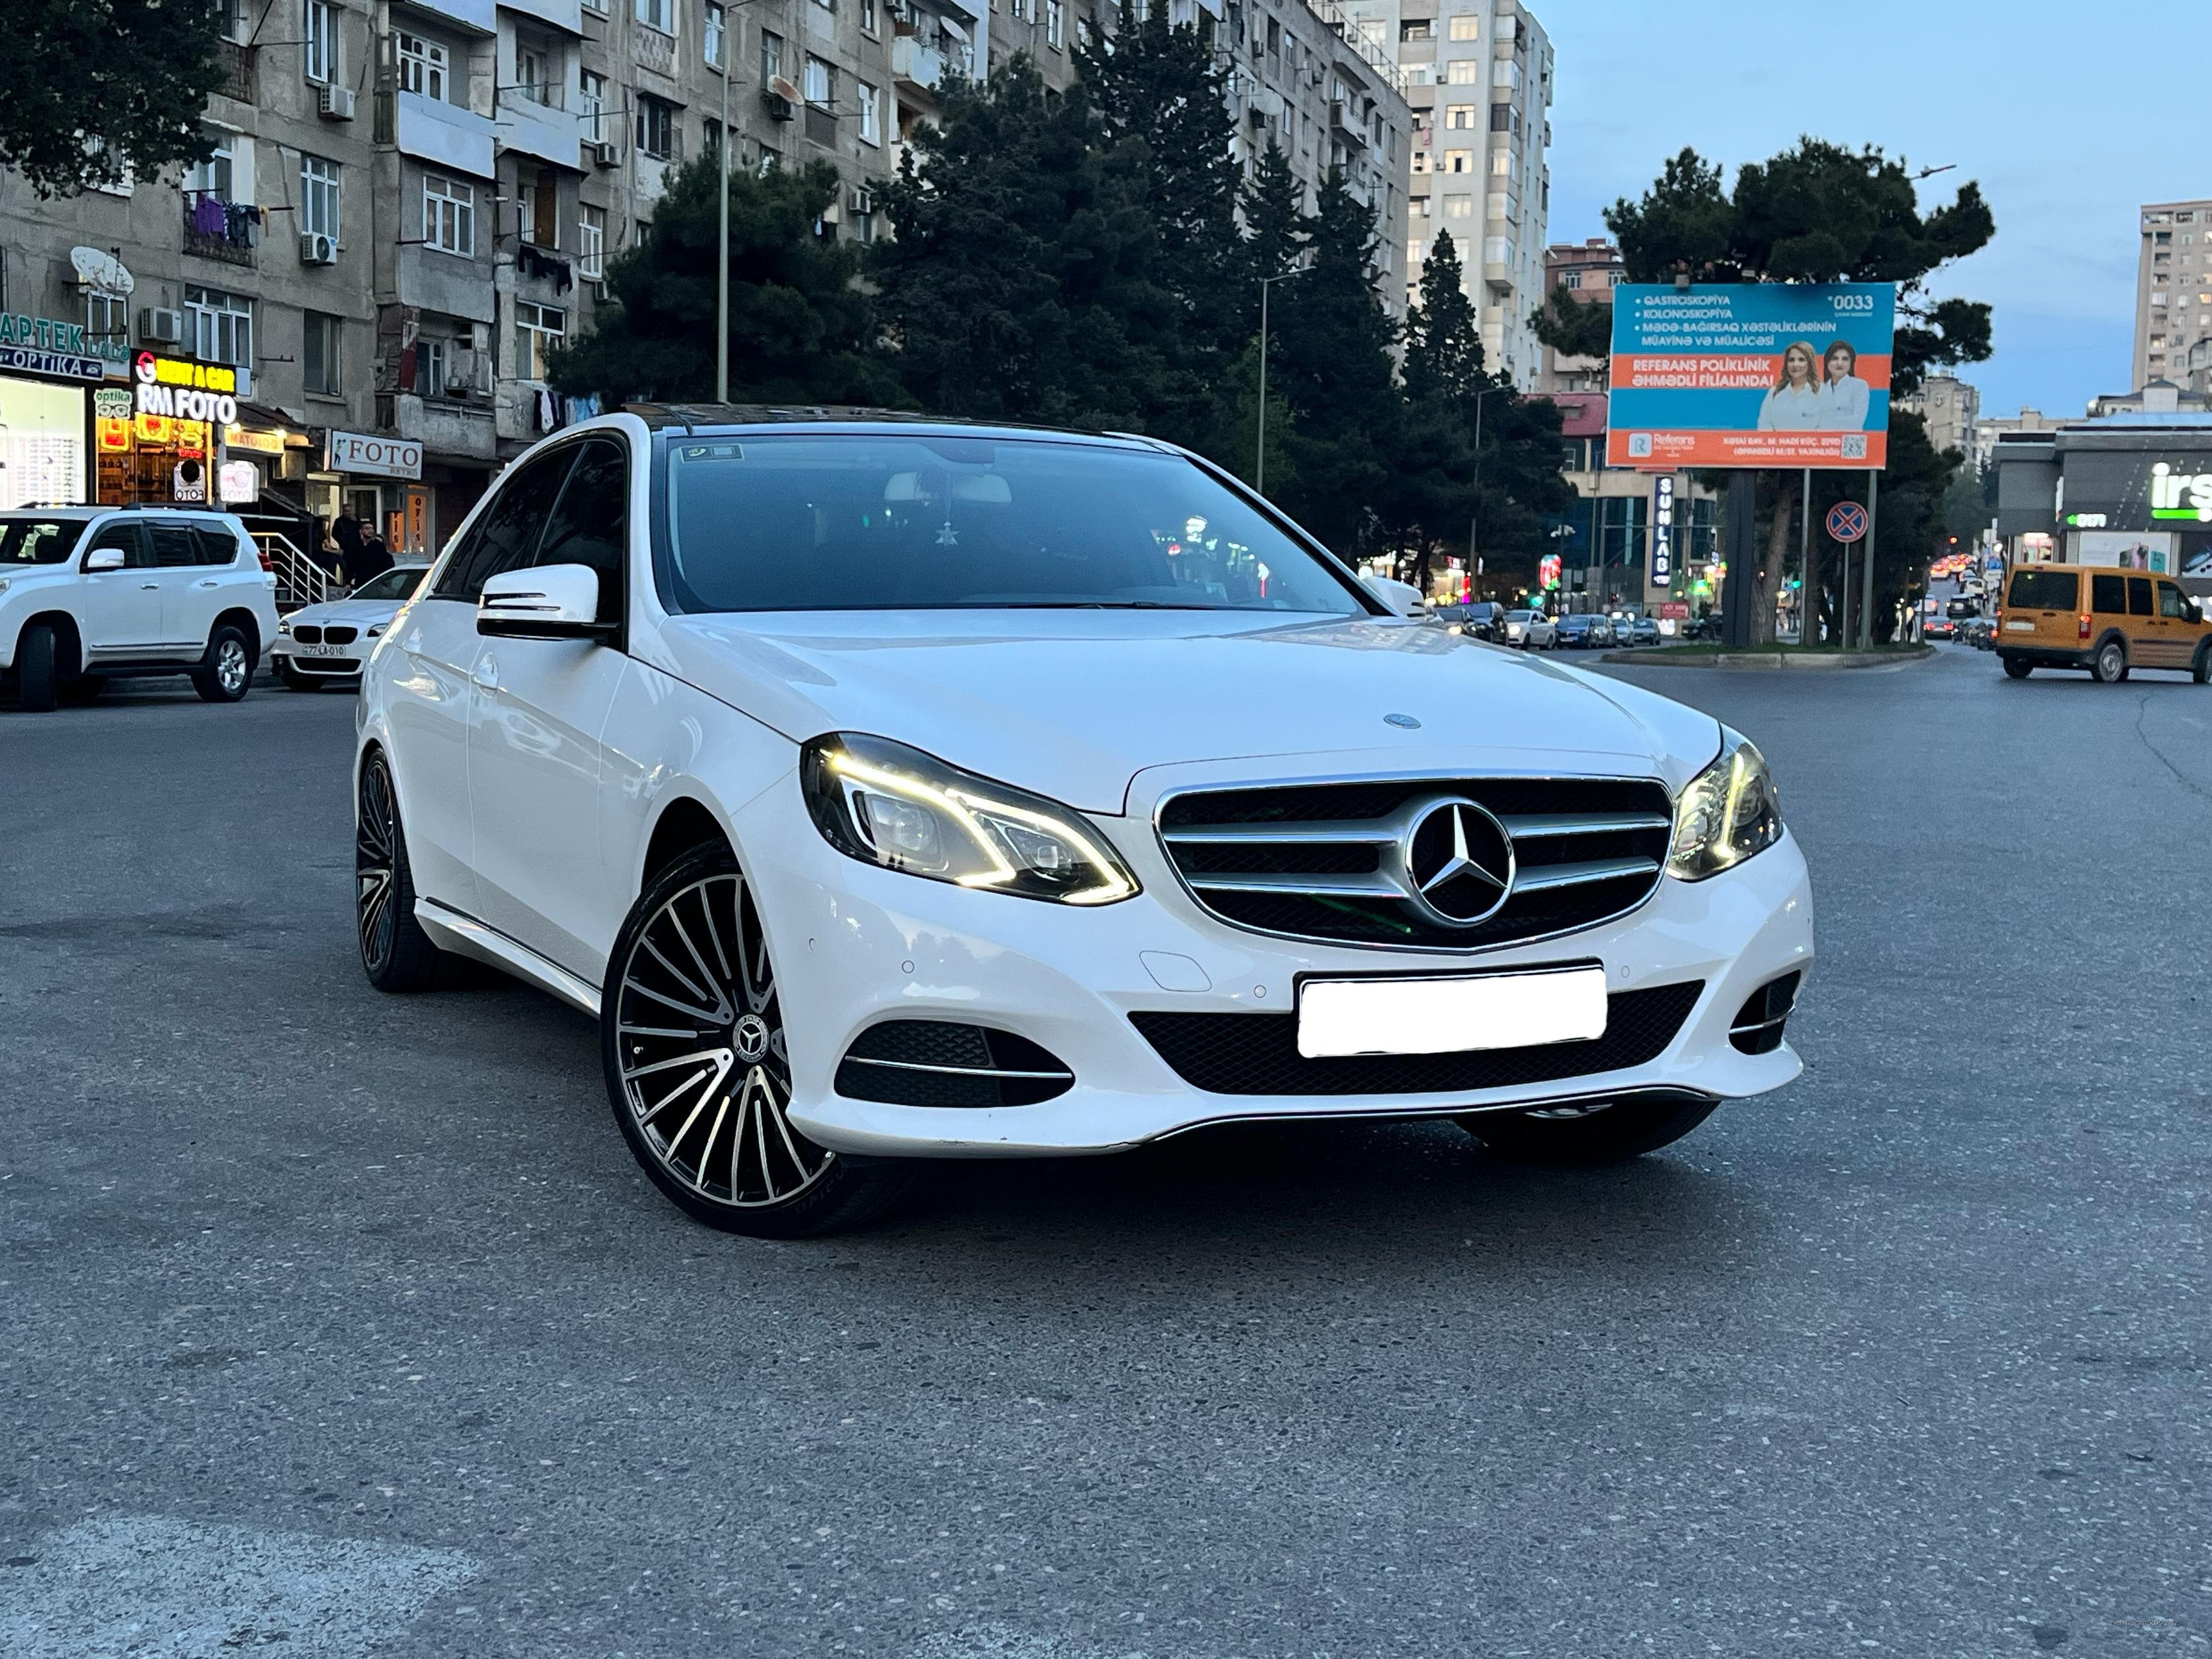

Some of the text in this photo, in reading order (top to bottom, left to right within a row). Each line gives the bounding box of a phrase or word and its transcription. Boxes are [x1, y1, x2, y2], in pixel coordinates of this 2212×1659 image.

[1643, 307, 1733, 319] KOLONOSKOPİYA
[0, 312, 84, 354] APTEK
[1695, 336, 1712, 346] VƏ
[156, 358, 194, 386] RENT
[1633, 359, 1697, 371] REFERANS
[1632, 373, 1696, 387] ƏHMƏDLİ
[96, 390, 131, 404] optika
[174, 389, 237, 425] FOTO
[348, 439, 419, 466] FOTO
[1656, 477, 1672, 573] SUNLAB
